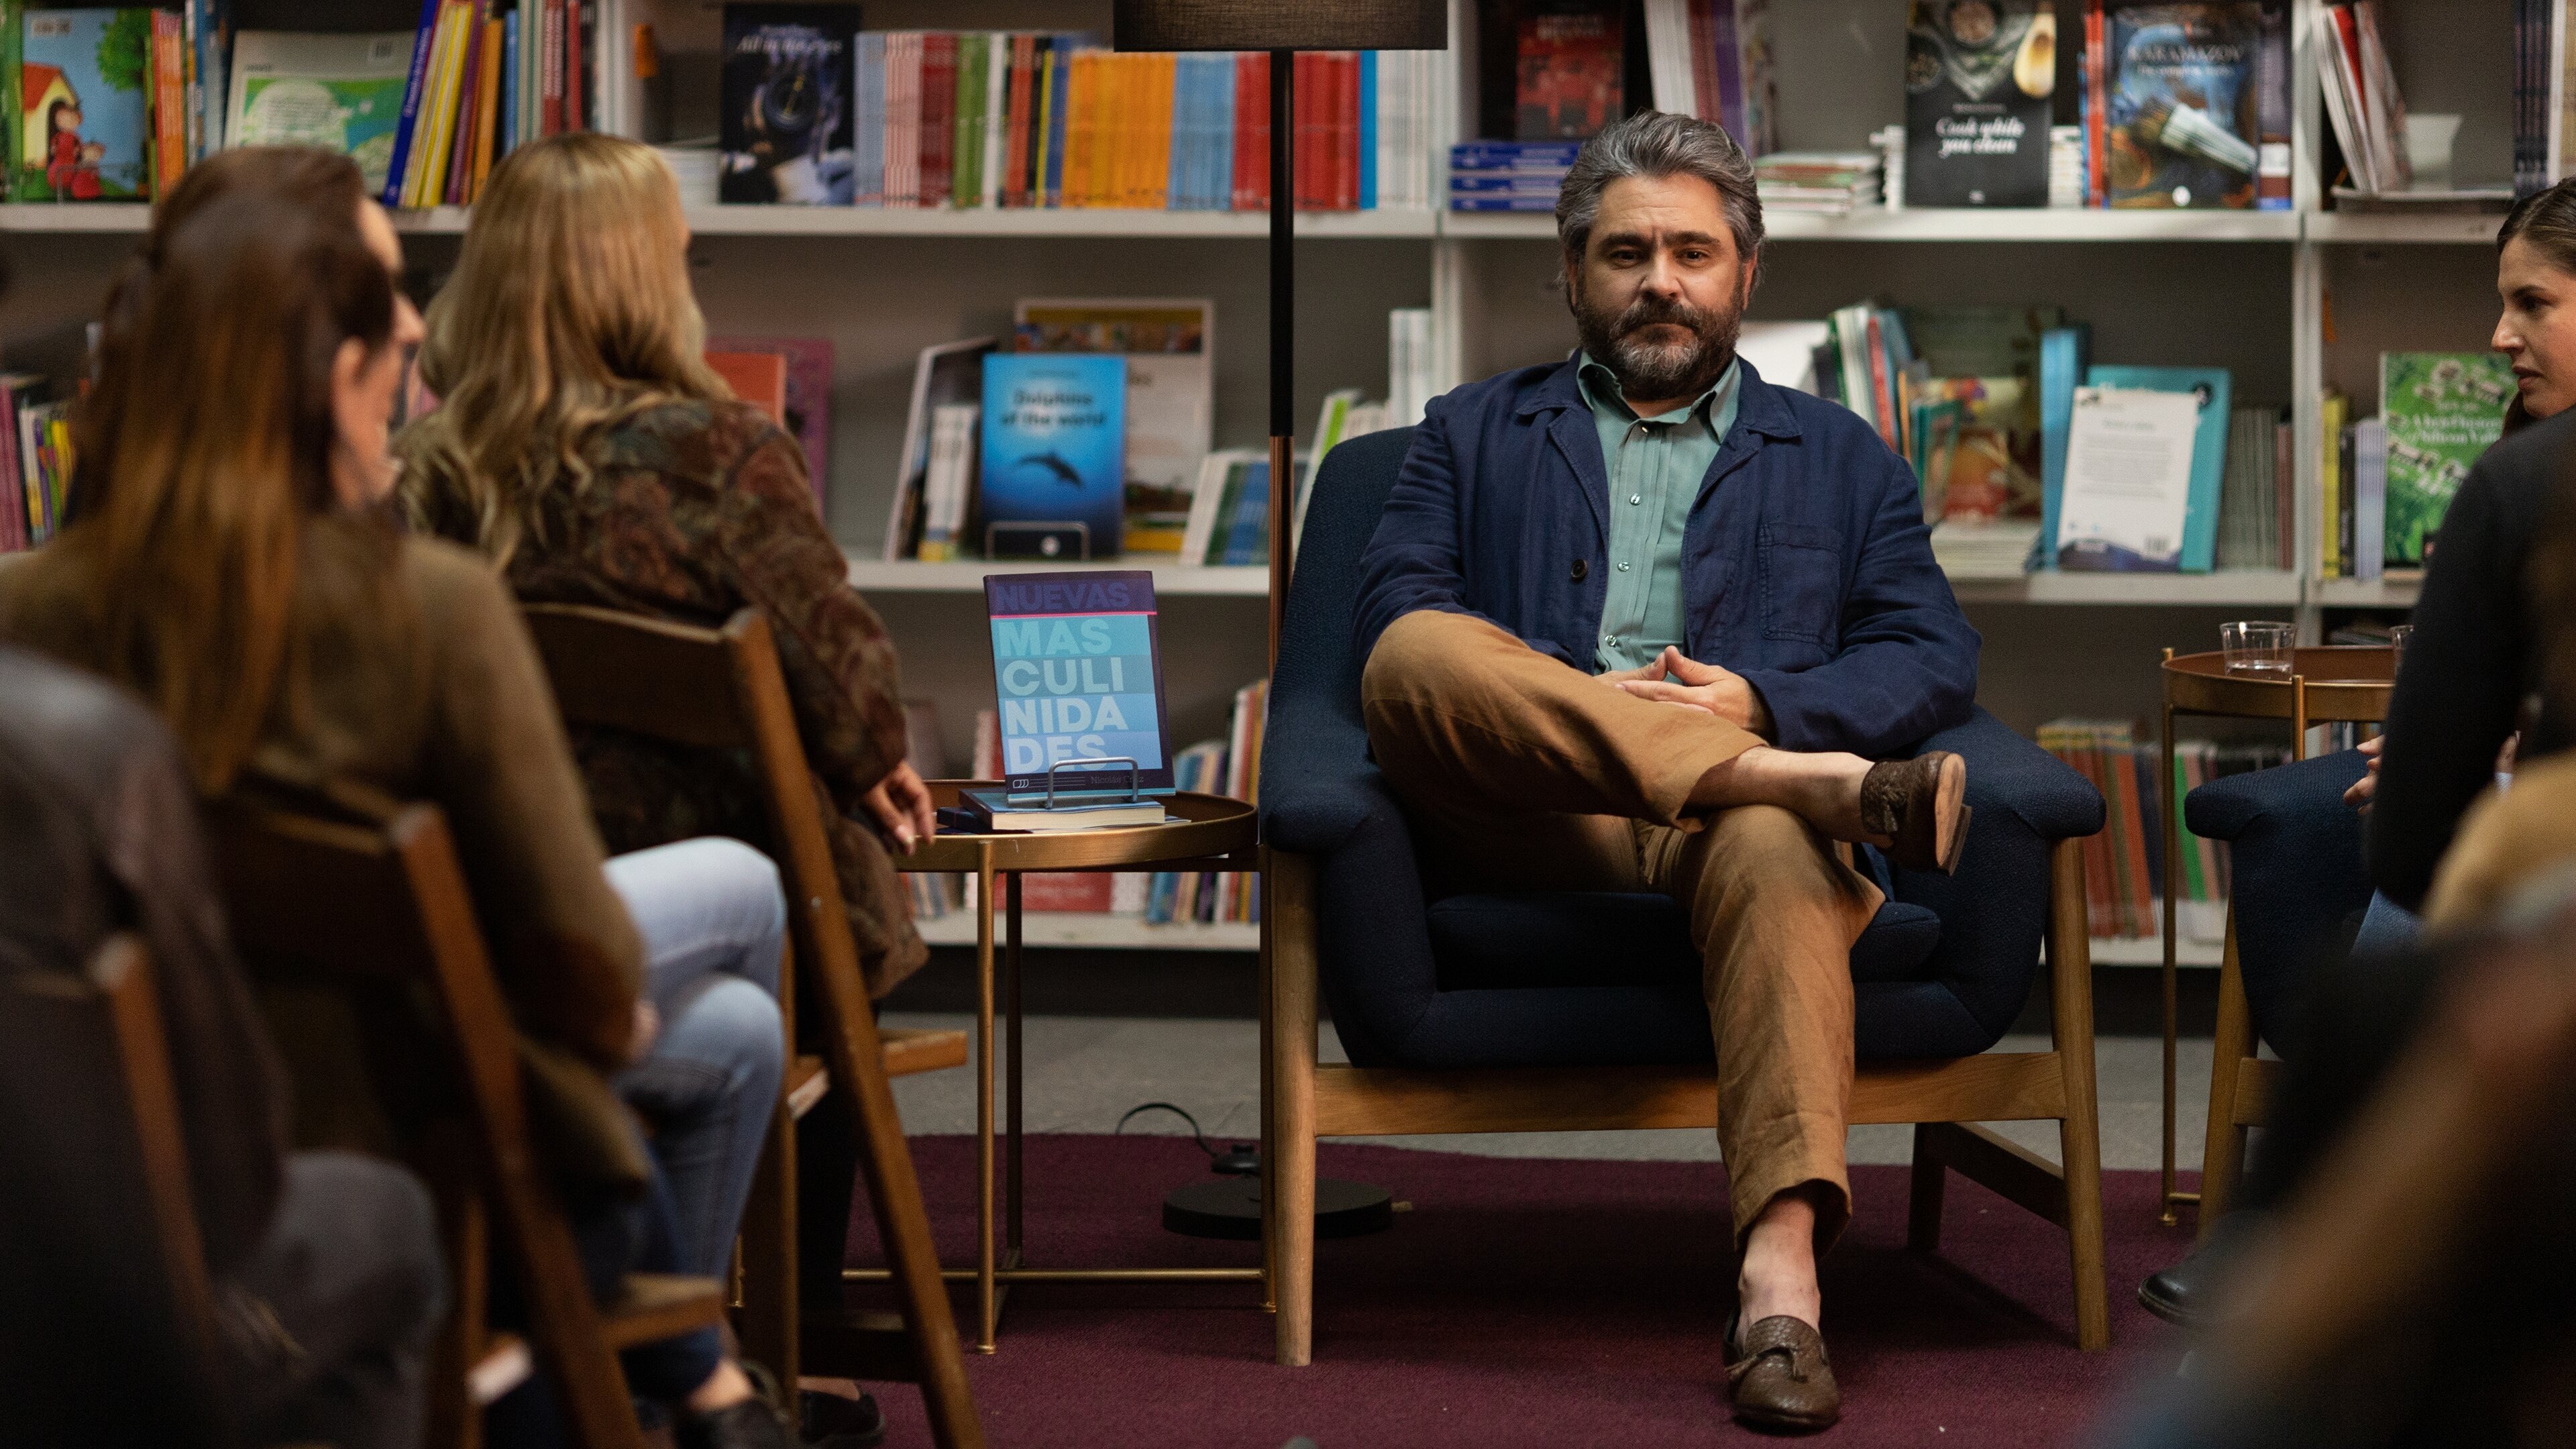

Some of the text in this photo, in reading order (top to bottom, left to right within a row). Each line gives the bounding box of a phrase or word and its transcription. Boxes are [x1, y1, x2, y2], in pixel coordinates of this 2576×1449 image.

[2128, 45, 2242, 62] KARAMAZOV
[1936, 117, 2025, 138] Cook while
[1939, 134, 2017, 158] you clean
[1014, 390, 1094, 407] Dolphins
[1000, 411, 1107, 428] of the world
[996, 581, 1130, 610] NUEVAS
[998, 618, 1113, 657] MAS
[1003, 657, 1124, 696] CULI
[1006, 696, 1128, 735] NIDA
[1008, 734, 1109, 773] DES
